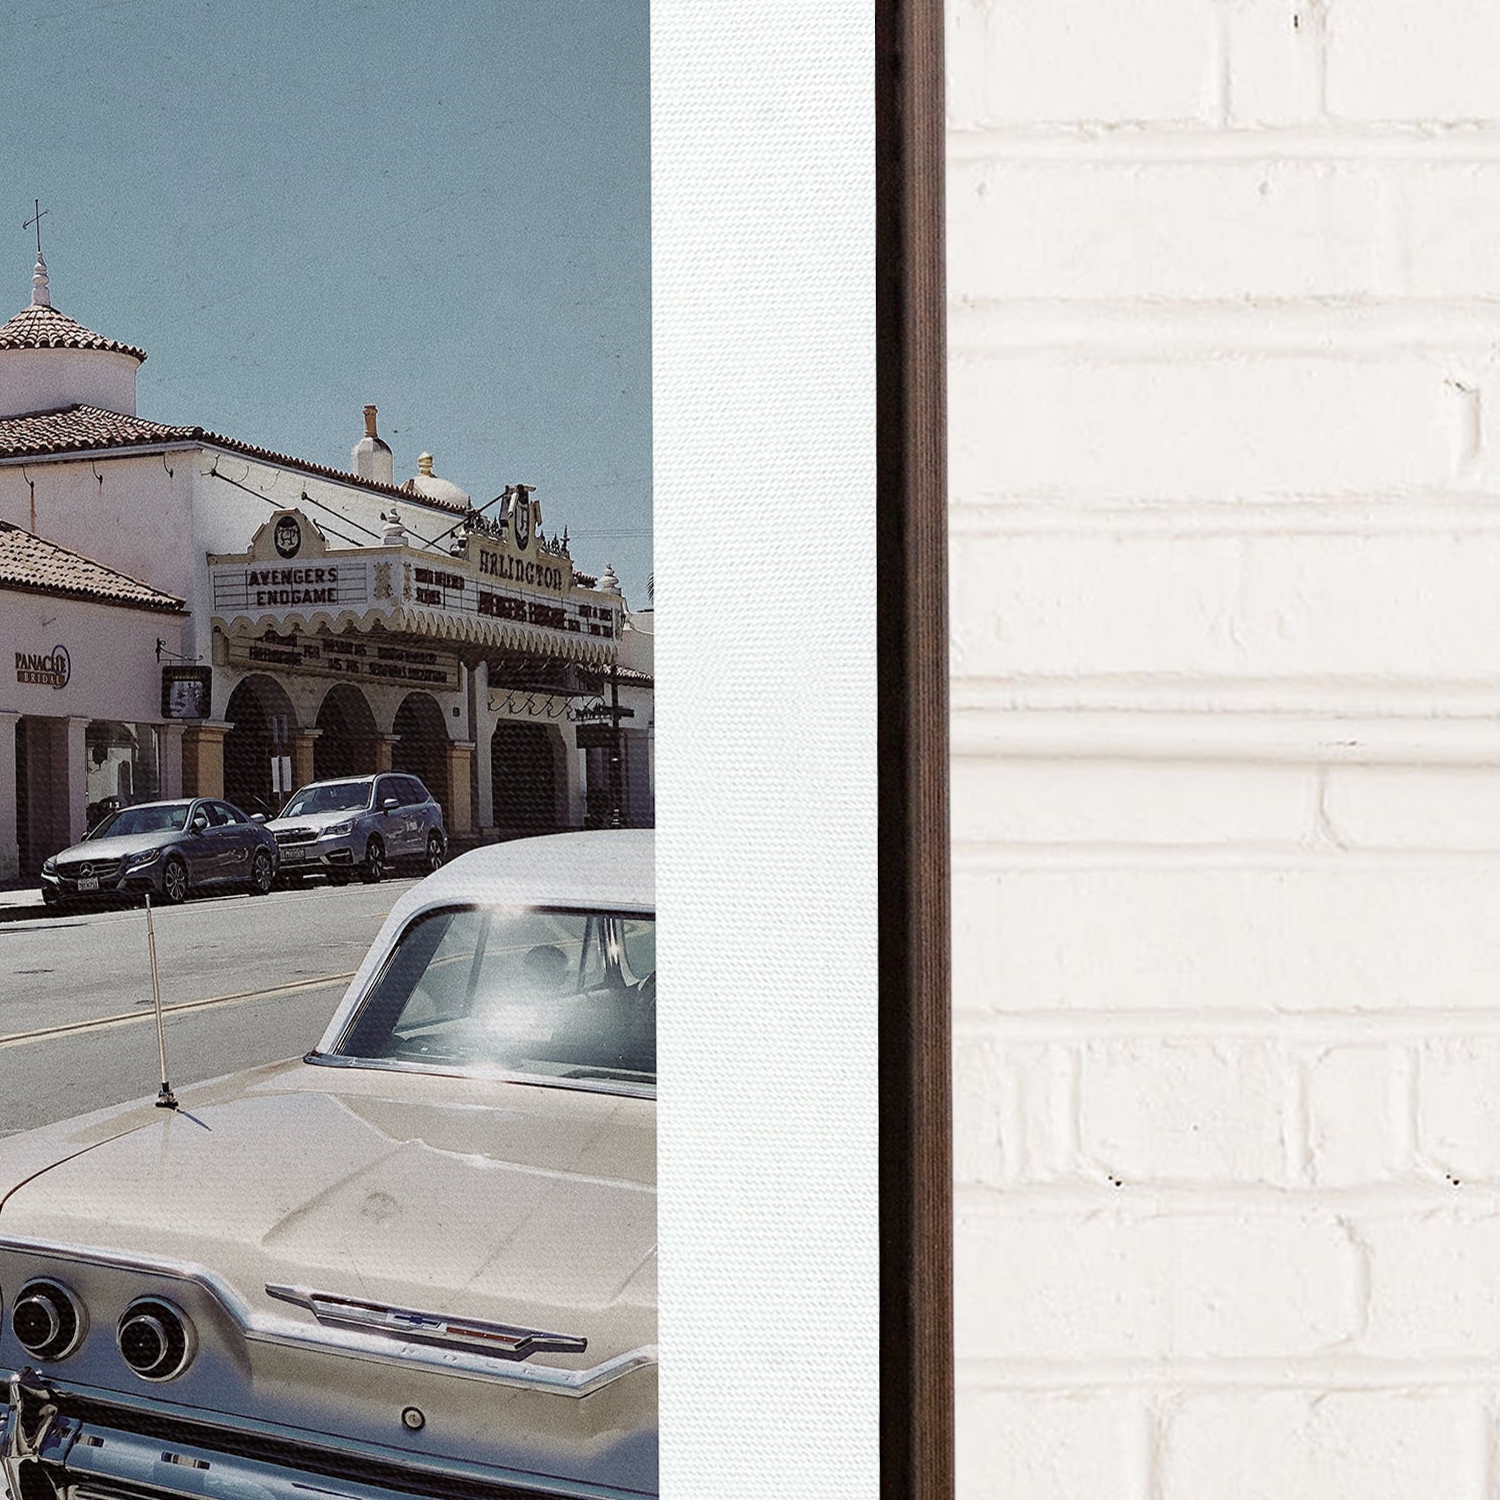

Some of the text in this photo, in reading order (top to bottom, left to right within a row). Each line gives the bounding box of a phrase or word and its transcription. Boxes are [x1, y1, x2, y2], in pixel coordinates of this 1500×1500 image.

[248, 567, 338, 587] AVENGERS
[479, 549, 563, 591] ARLINGTON
[256, 587, 338, 607] ENDGAME
[15, 652, 67, 674] PANACHE
[23, 672, 62, 685] BRIDAL
